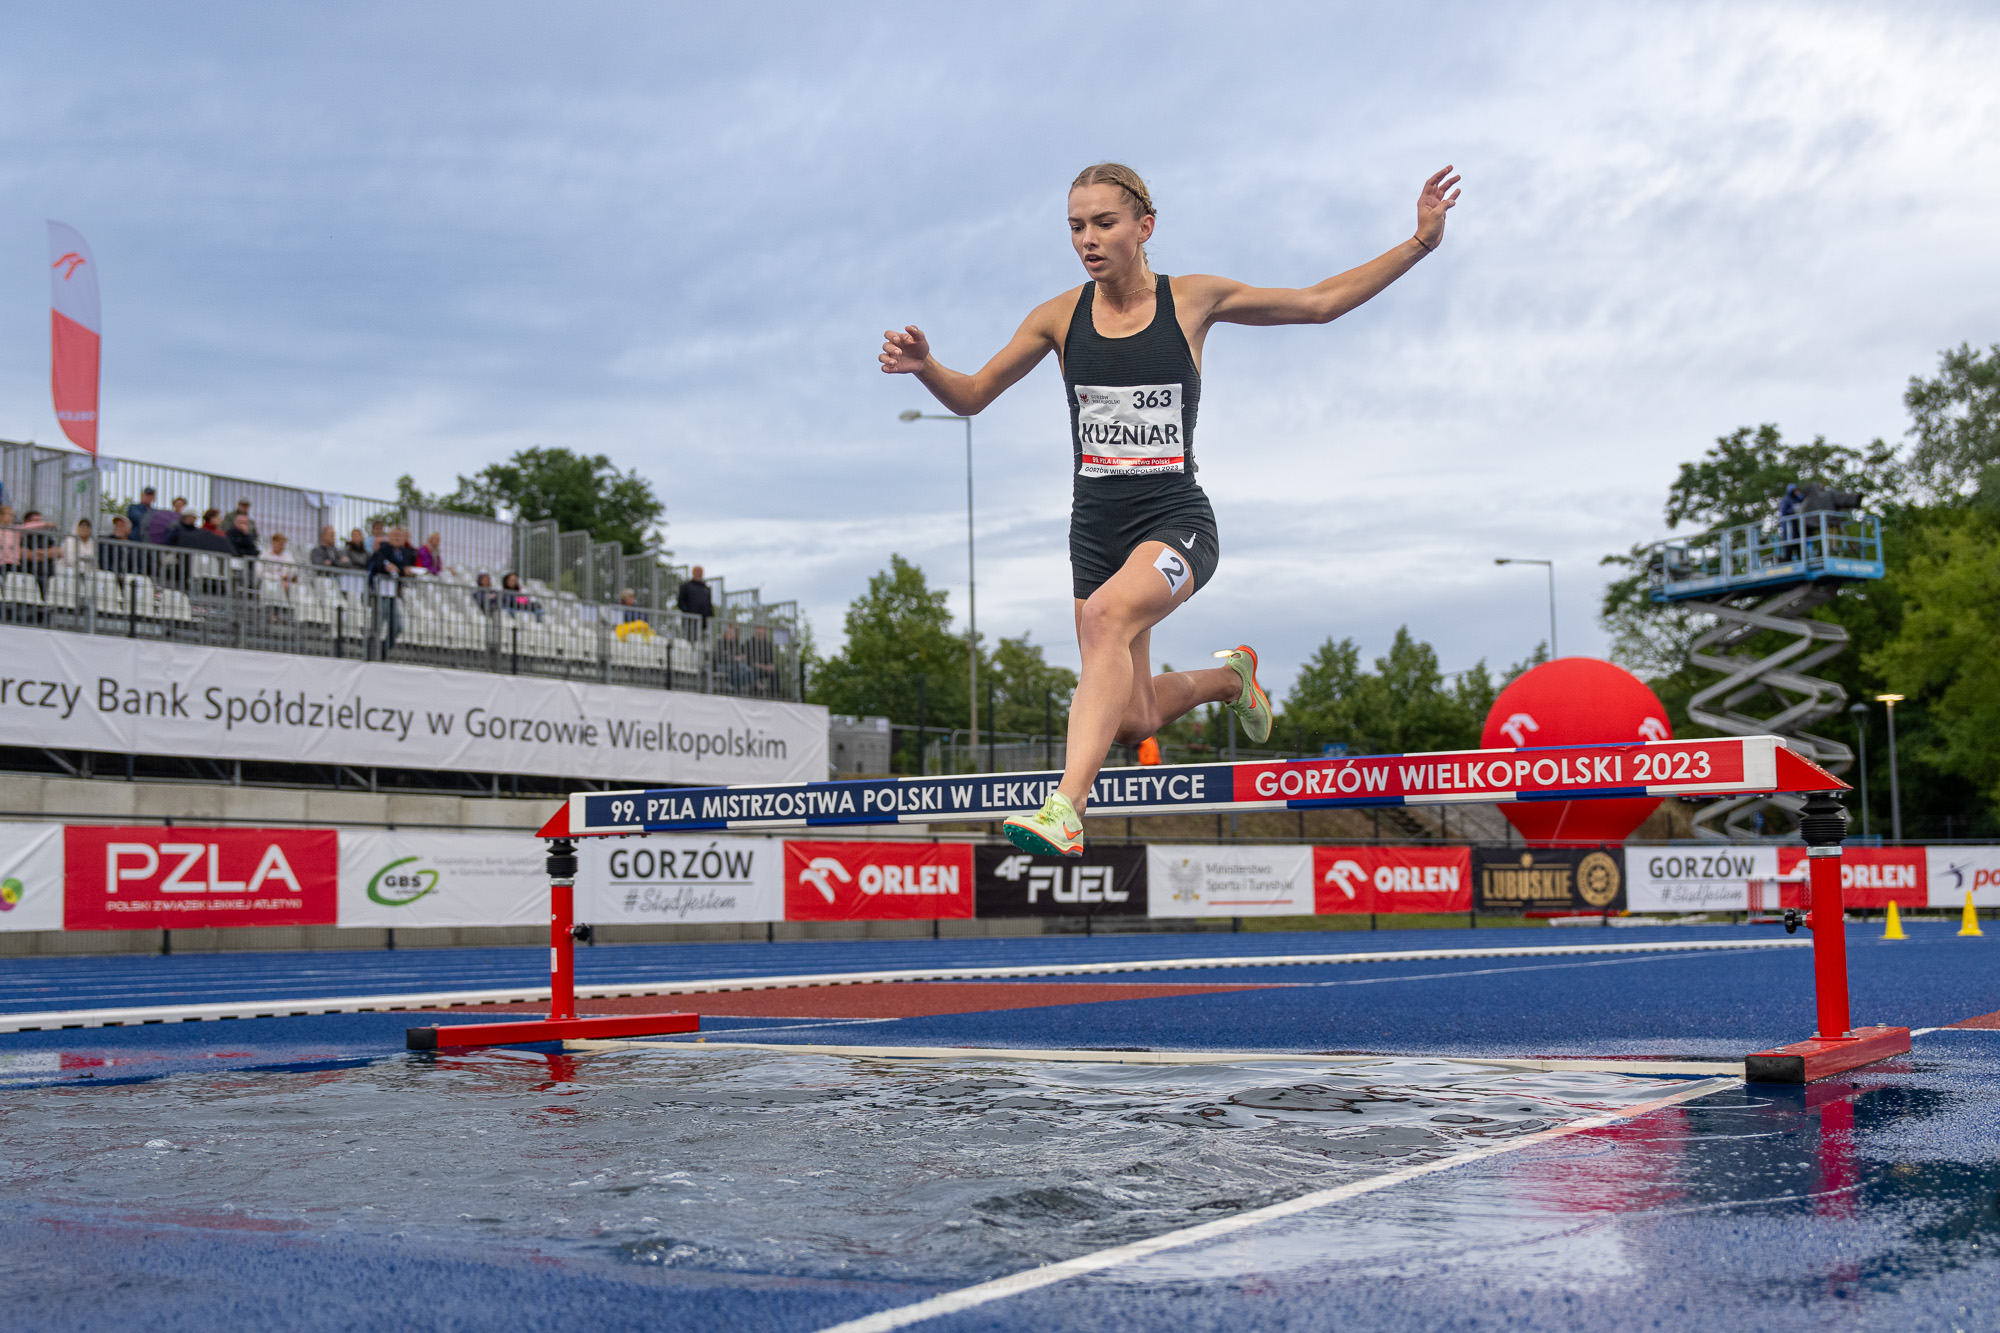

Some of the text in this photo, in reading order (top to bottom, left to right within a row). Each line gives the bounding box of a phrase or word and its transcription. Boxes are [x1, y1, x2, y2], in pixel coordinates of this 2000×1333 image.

[1132, 389, 1172, 409] 363
[1081, 420, 1180, 446] KUŹNIAR
[1084, 464, 1179, 475] GORZÓW WIELKOPOLSKI 2023
[1161, 556, 1185, 587] 2
[97, 676, 190, 719] Bank
[204, 686, 414, 742] Spółdzielczy
[427, 710, 455, 736] w
[465, 707, 599, 747] Gorzowie
[607, 718, 788, 761] Wielkopolskim
[610, 800, 641, 823] 99.
[647, 797, 696, 821] PZLA
[701, 791, 856, 819] MISTRZOSTWA
[863, 786, 943, 812] POLSKI
[950, 784, 974, 809] W
[1255, 759, 1390, 797] GORZÓW
[1398, 754, 1623, 791] WIELKOPOLSKI
[1632, 749, 1712, 782] 2023
[106, 842, 302, 893] PZLA
[609, 841, 754, 879] GORZÓW
[1649, 849, 1755, 879] GORZÓW
[384, 875, 422, 888] GBS
[858, 864, 960, 895] ORLEN
[994, 855, 1129, 903] 4F FUEL
[1374, 866, 1460, 892] ORLEN
[1482, 869, 1573, 900] LUBUSKIE
[1841, 864, 1916, 889] ORLEN
[105, 900, 151, 913] POLSKI
